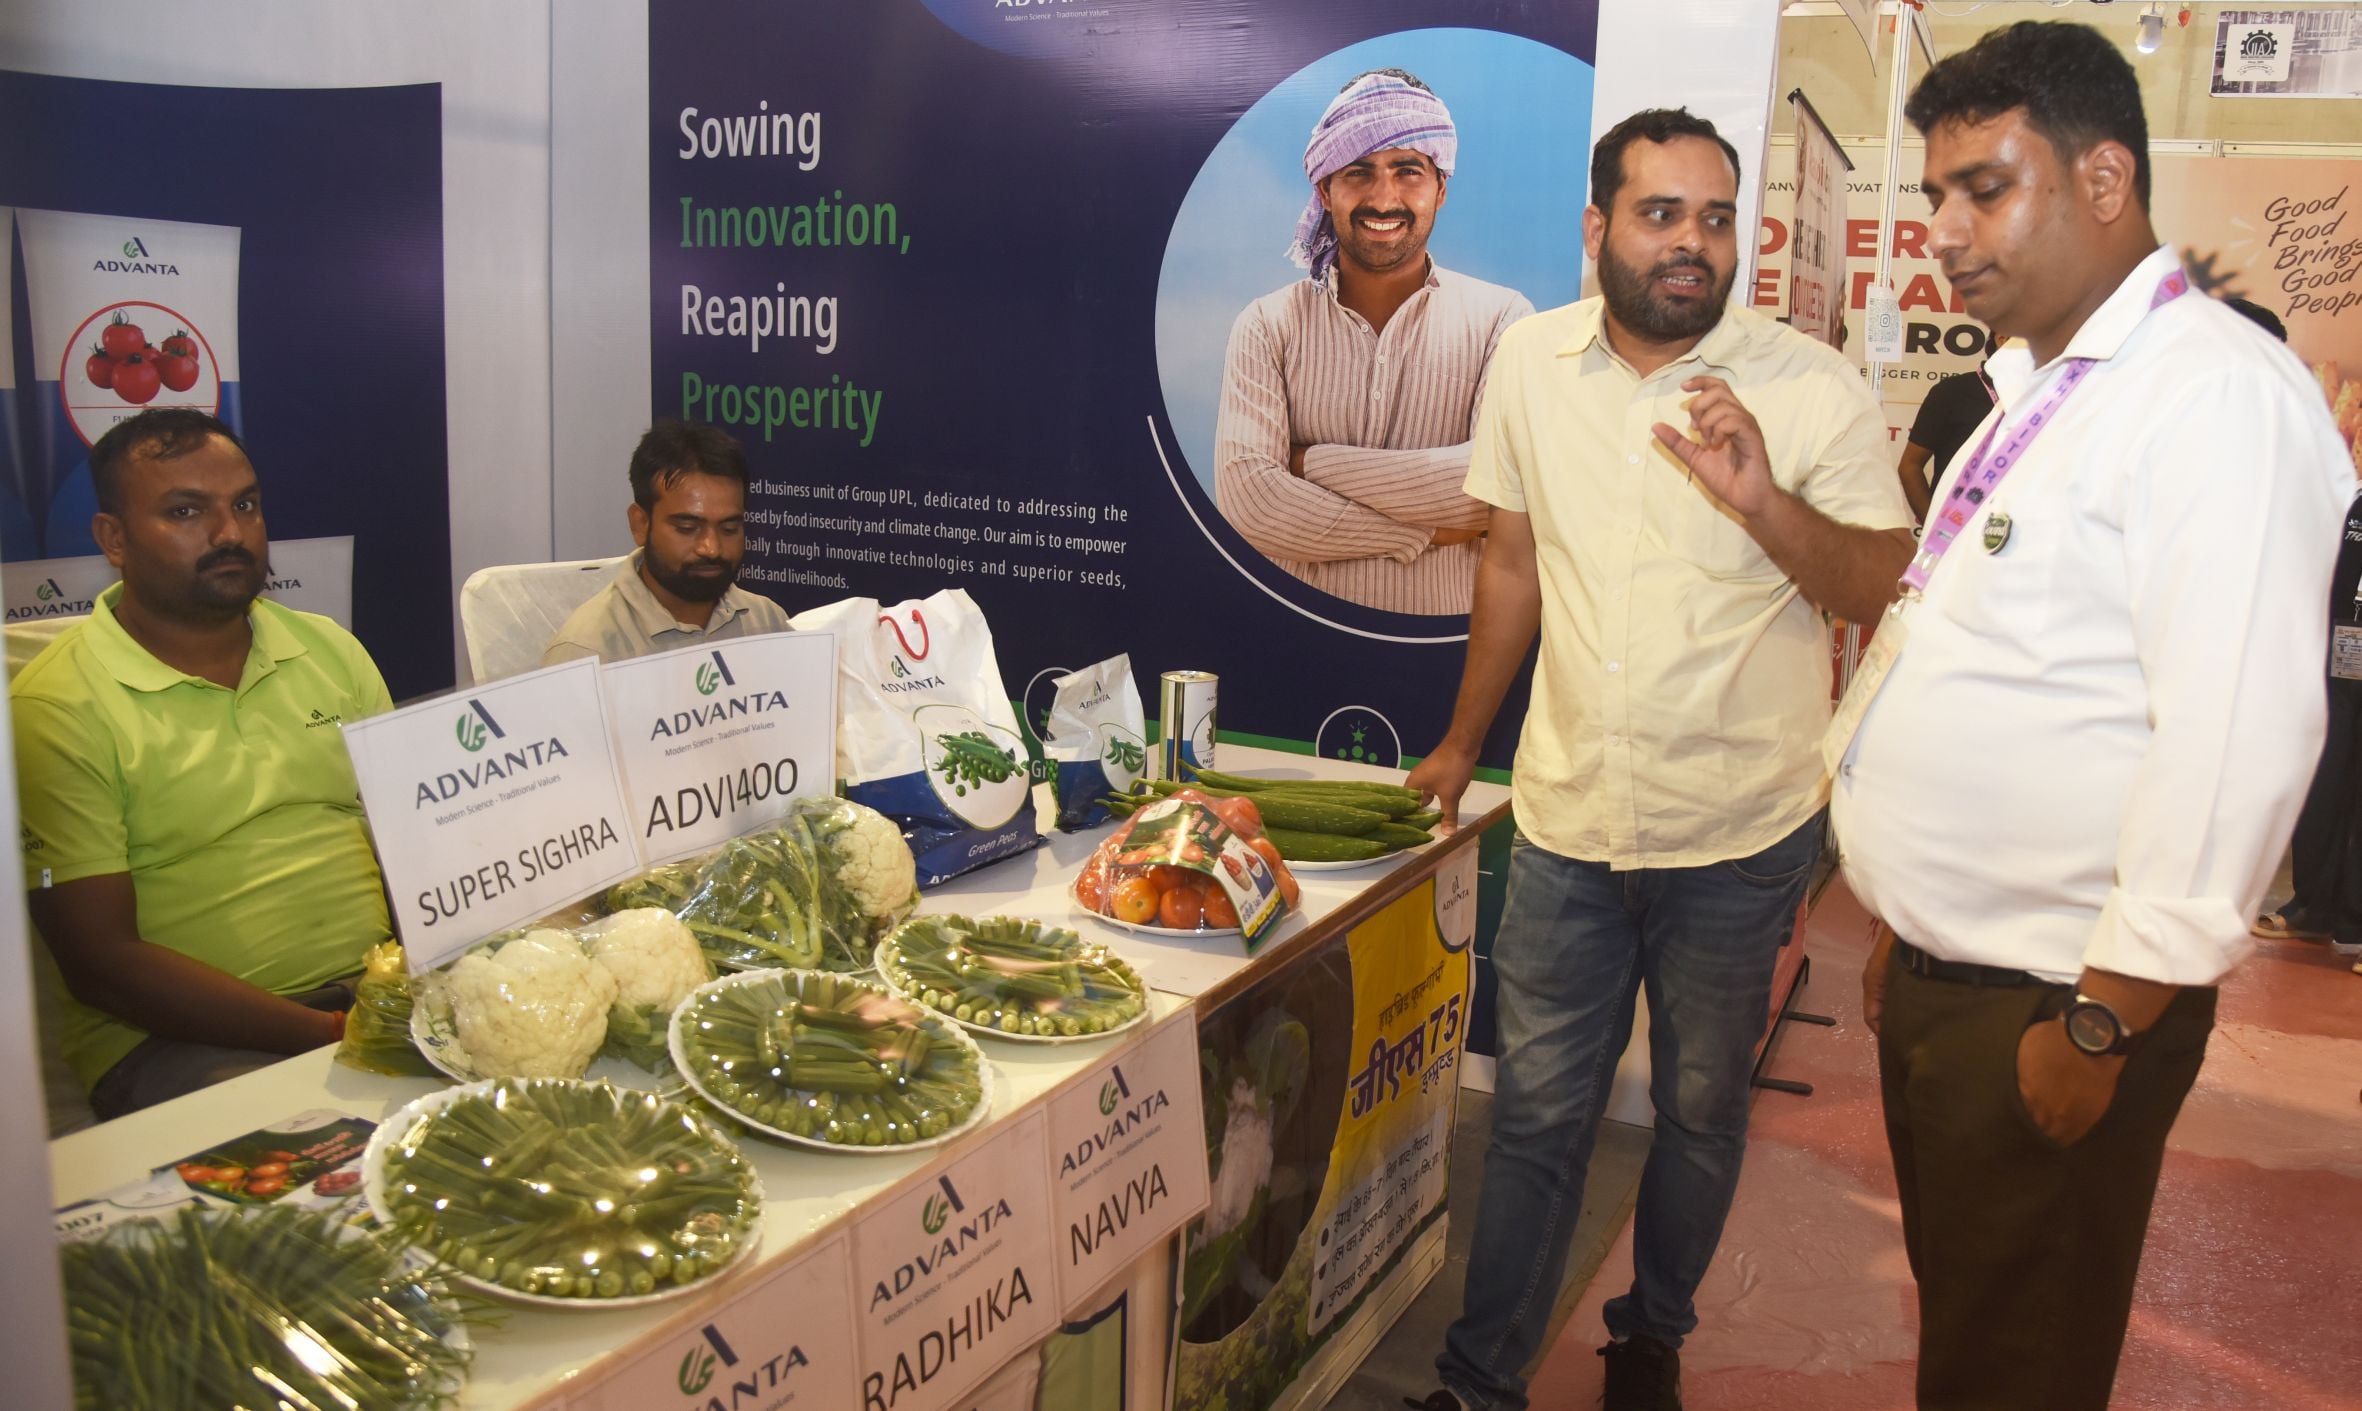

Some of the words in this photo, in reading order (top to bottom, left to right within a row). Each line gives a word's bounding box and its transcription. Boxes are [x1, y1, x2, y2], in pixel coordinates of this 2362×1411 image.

[680, 100, 820, 170] Sowing
[680, 190, 910, 254] Innovation,
[2264, 185, 2349, 222] Good
[2267, 210, 2348, 247] Food
[93, 260, 180, 276] ADVANTA
[2273, 238, 2362, 270] Brings
[2281, 260, 2362, 293] Good
[682, 282, 838, 354] Reaping
[683, 372, 883, 448] Prosperity
[765, 480, 811, 498] business
[813, 484, 835, 500] unit
[838, 485, 849, 501] of
[851, 486, 886, 507] Group
[889, 488, 917, 508] UPL,
[923, 490, 990, 511] dedicated
[997, 497, 1011, 513] to
[1017, 498, 1096, 524] addressing
[1104, 504, 1128, 522] the
[769, 509, 782, 529] by
[783, 510, 807, 528] food
[809, 512, 863, 536] insecurity
[864, 519, 885, 534] and
[889, 518, 930, 537] climate
[933, 522, 981, 545] change.
[983, 526, 1007, 543] Our
[1009, 528, 1032, 546] aim
[1035, 530, 1045, 547] is
[1049, 532, 1062, 548] to
[1064, 535, 1127, 556] empower
[767, 568, 787, 583] and
[788, 568, 850, 590] livelihoods.
[775, 538, 821, 561] through
[825, 543, 886, 564] innovative
[889, 549, 974, 575] technologies
[981, 559, 1006, 576] and
[1012, 562, 1074, 583] superior
[1079, 569, 1127, 591] seeds,
[5, 600, 95, 620] ADVANTA
[880, 675, 945, 693] ADVANTA
[650, 690, 789, 741] ADVANTA
[664, 743, 692, 758] Modern
[692, 735, 714, 750] Science
[717, 724, 751, 742] Traditional
[751, 720, 776, 732] Values
[416, 736, 569, 810] ADVANTA
[435, 808, 467, 827] Modern
[466, 798, 494, 816] Science
[498, 781, 537, 802] Traditional
[537, 773, 562, 789] Values
[418, 860, 517, 927] SUPER
[518, 816, 619, 882] SIGHRA
[967, 838, 996, 858] Green
[1350, 1020, 1427, 1119] जीएस
[1429, 992, 1462, 1057] 75
[1059, 1088, 1170, 1180] ADVANTA
[1070, 1163, 1169, 1266] NAVYA
[869, 1198, 1013, 1314] ADVANTA
[863, 1265, 1033, 1411] RADHIKA
